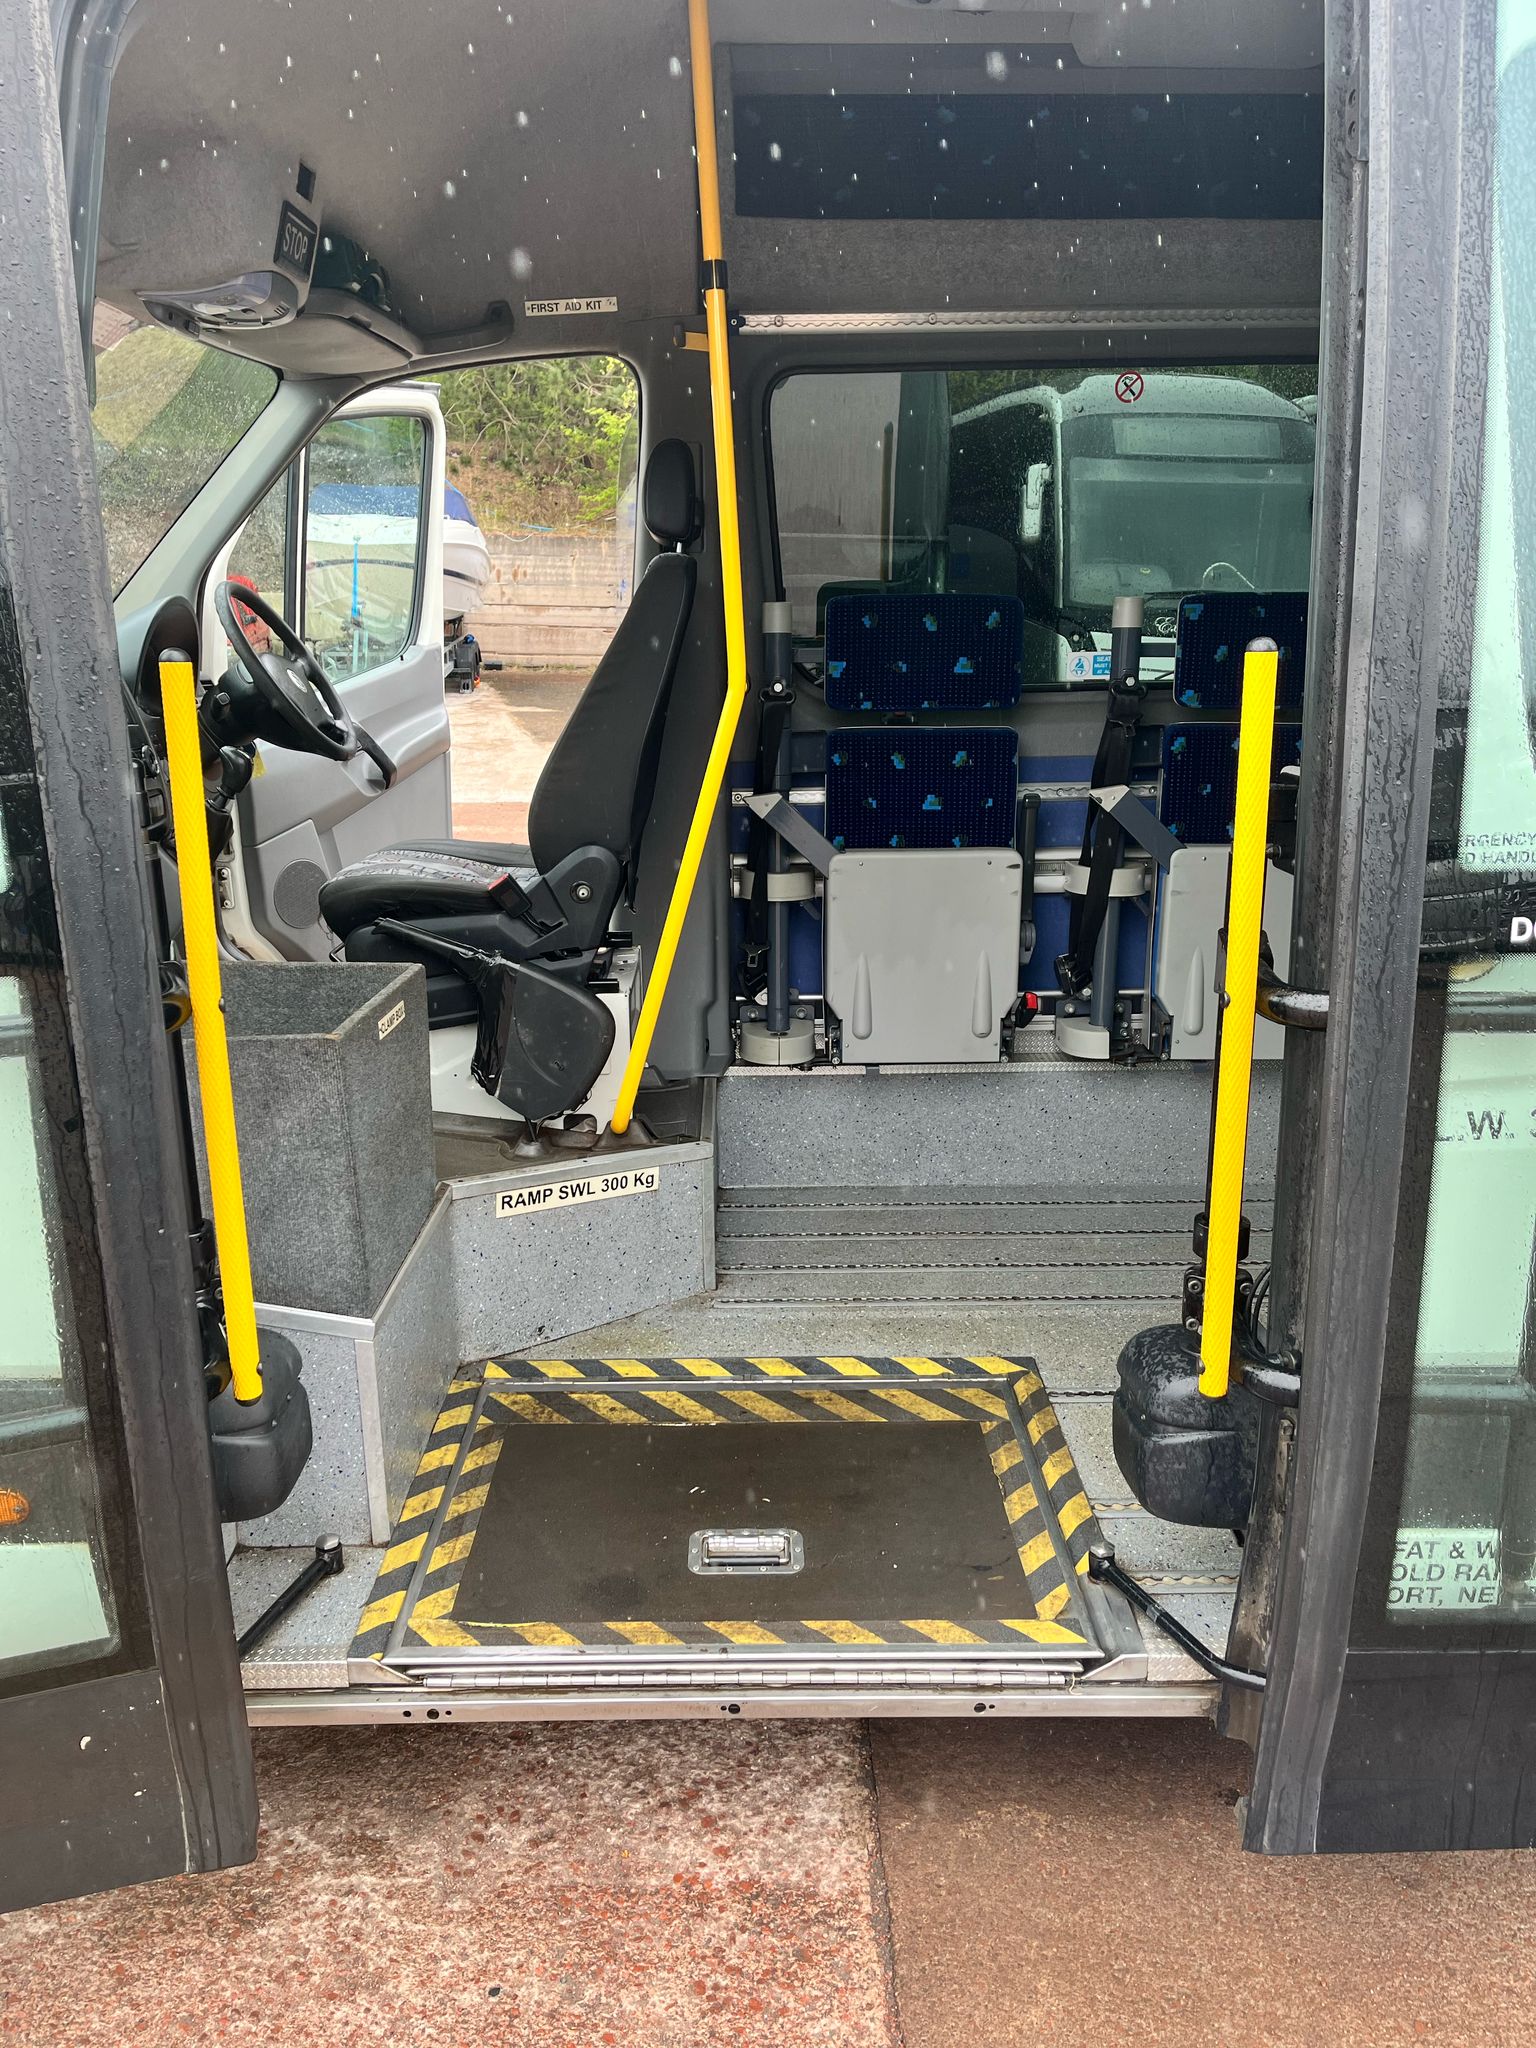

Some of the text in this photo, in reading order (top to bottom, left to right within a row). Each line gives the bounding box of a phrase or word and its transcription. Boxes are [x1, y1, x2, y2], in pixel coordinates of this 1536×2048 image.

[283, 223, 308, 262] STOP
[531, 300, 602, 313] FIRST AID KIT
[501, 1172, 655, 1210] RAMP SWL 300 Kg
[1449, 1541, 1464, 1559] &
[1391, 1563, 1445, 1581] OLD
